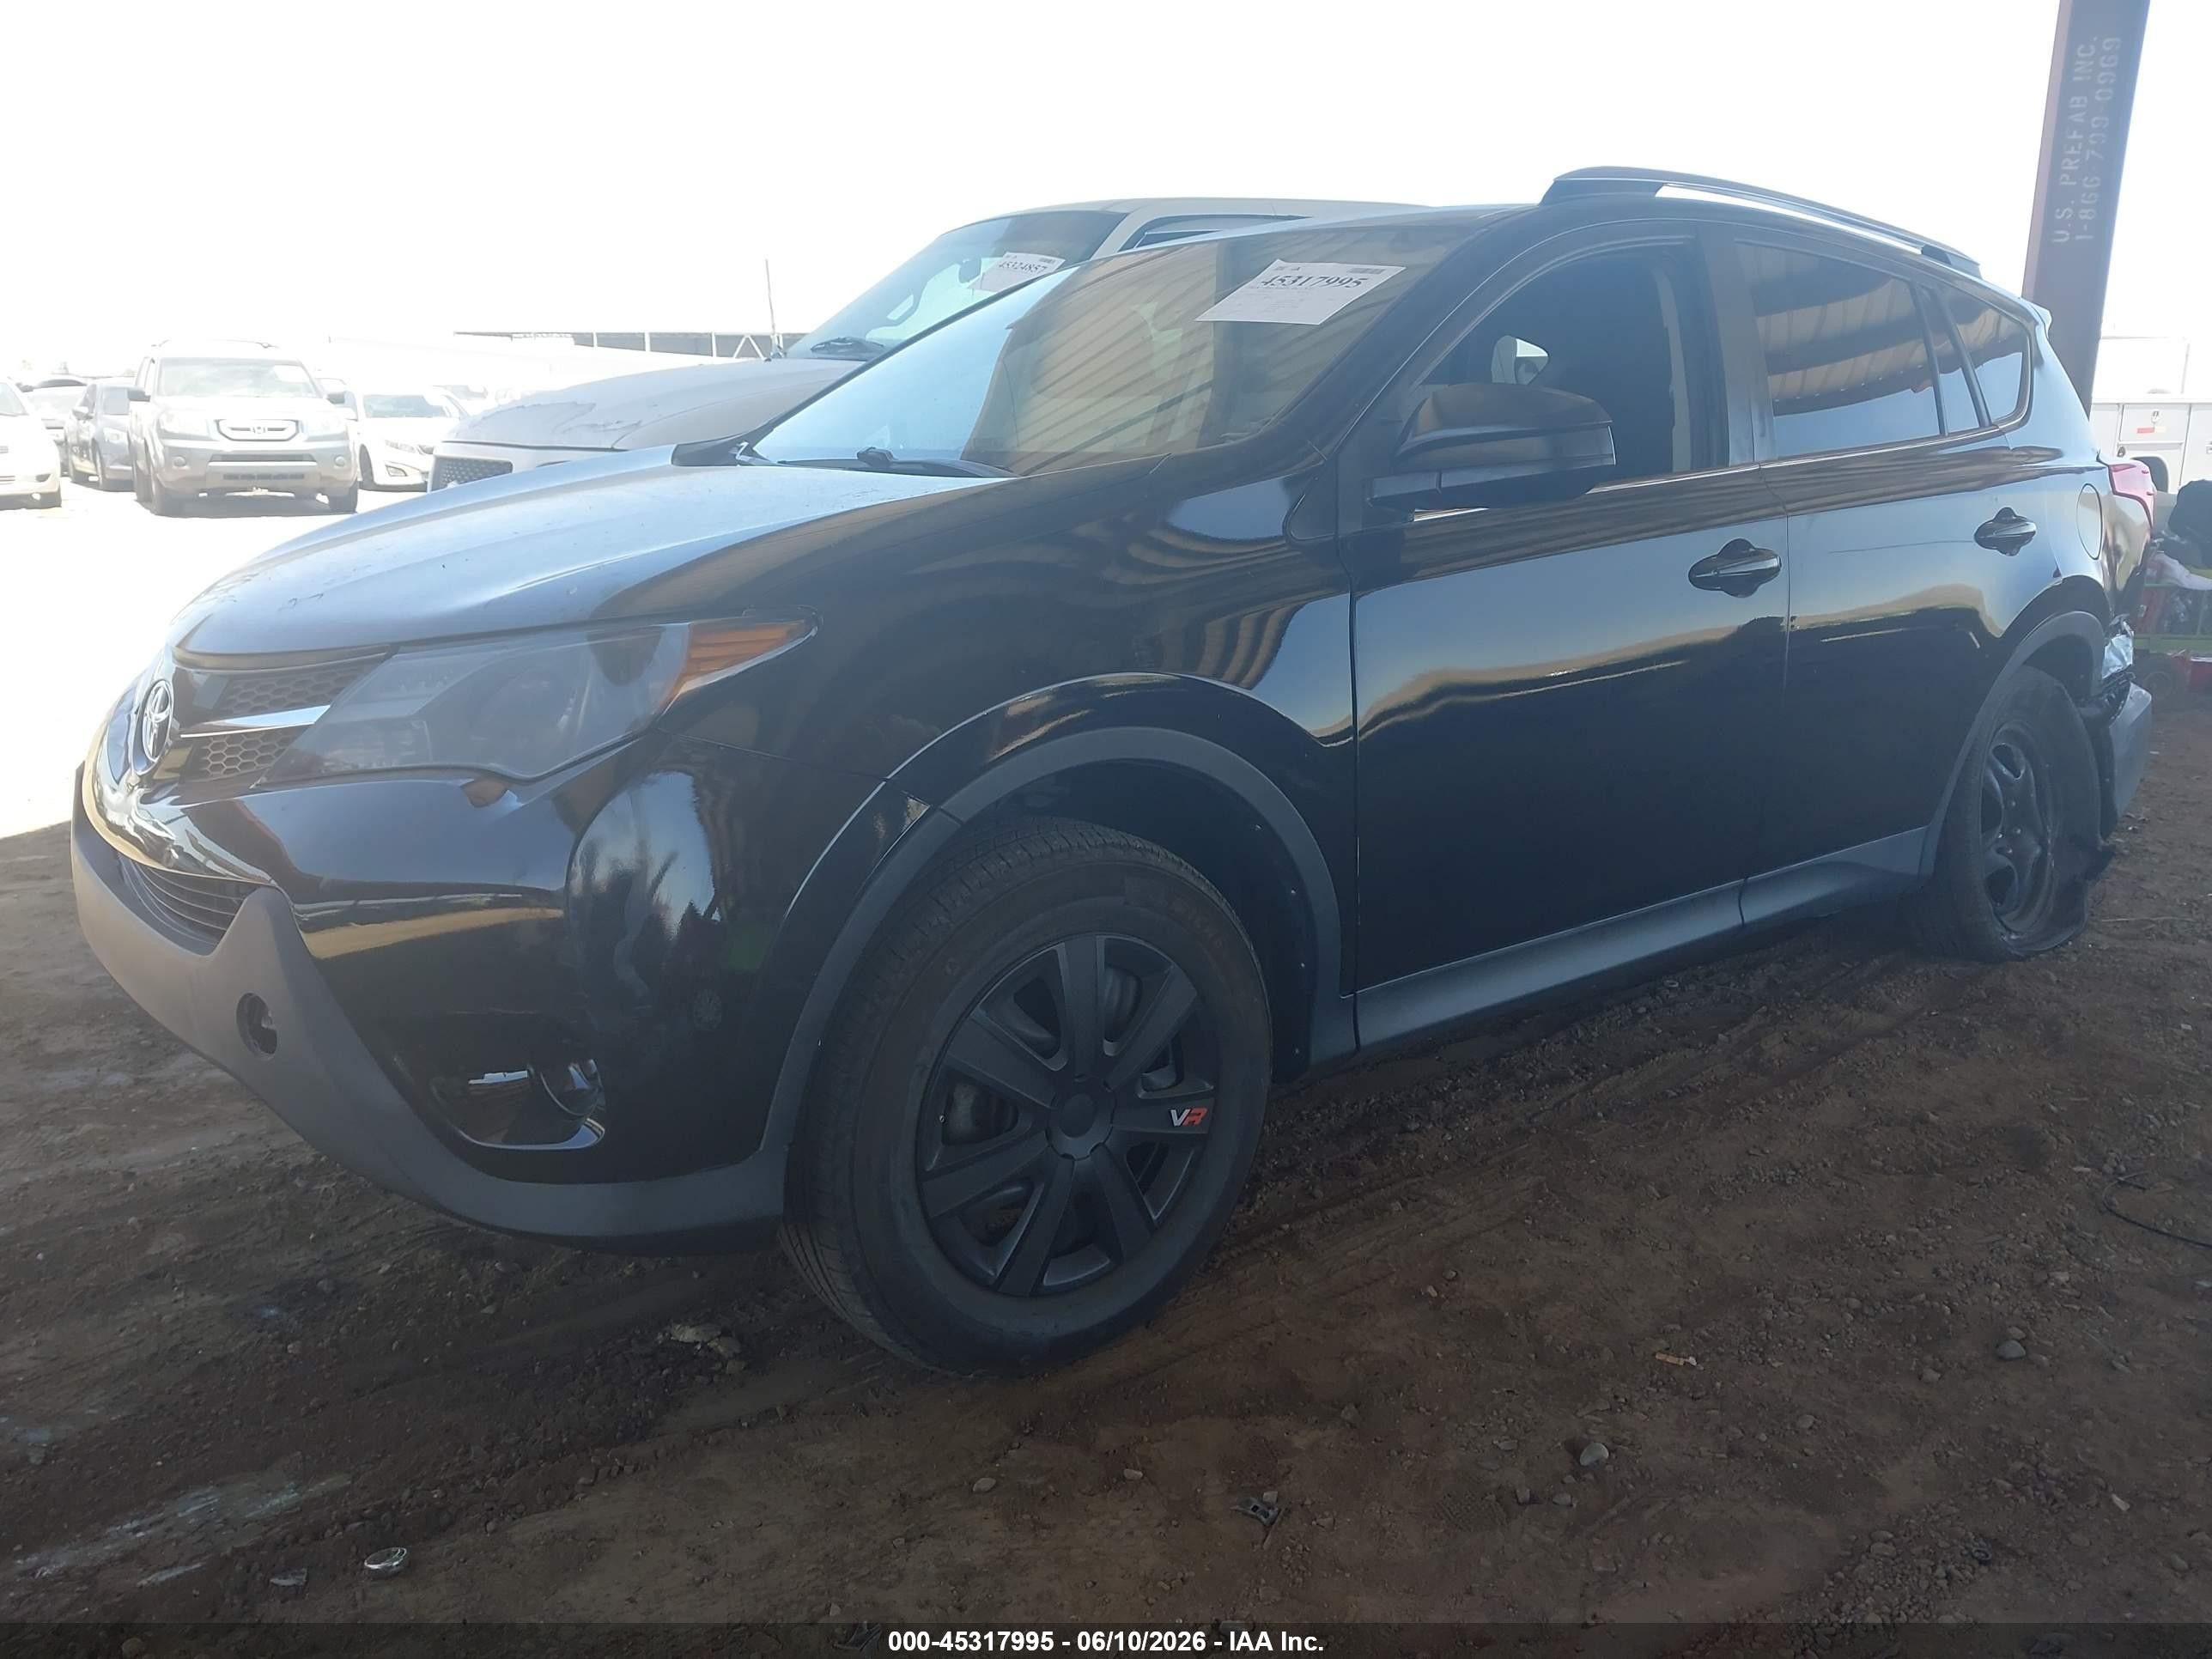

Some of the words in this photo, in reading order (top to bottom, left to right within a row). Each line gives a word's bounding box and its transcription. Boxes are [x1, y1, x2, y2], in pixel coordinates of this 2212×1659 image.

[2073, 35, 2098, 82] INC.
[2059, 94, 2088, 186] PREFAB
[2052, 199, 2075, 244] U.S.
[1261, 274, 1369, 289] 45317995
[1170, 1108, 1207, 1127] VR
